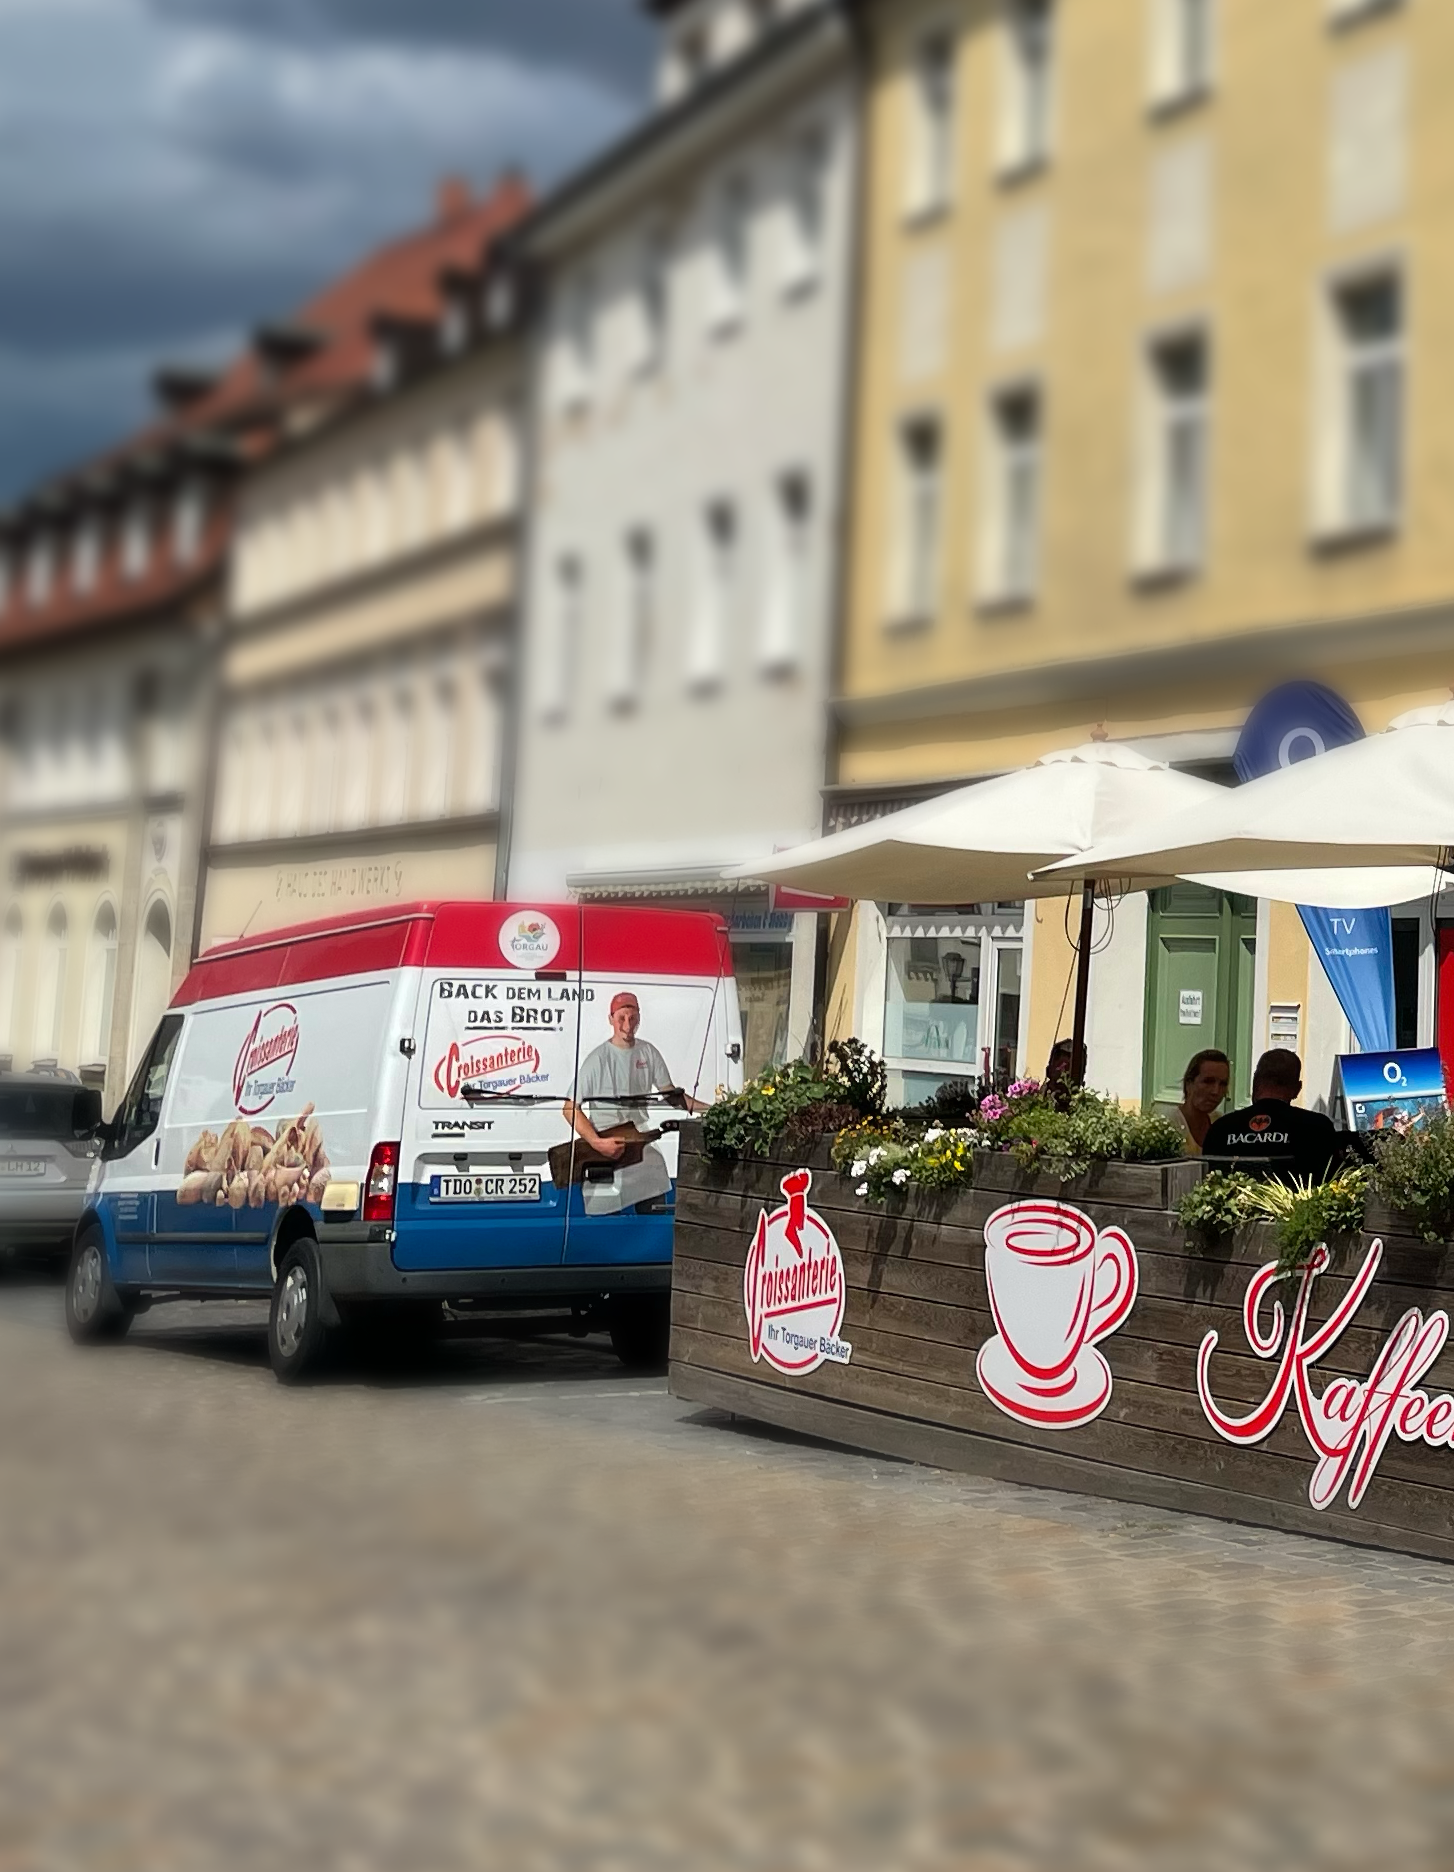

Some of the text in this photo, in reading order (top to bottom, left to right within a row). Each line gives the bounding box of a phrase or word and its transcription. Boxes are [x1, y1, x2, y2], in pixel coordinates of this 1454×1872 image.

[1329, 917, 1356, 936] TV
[1325, 946, 1379, 957] Smartphones
[439, 981, 595, 1003] BACK DEM LAND
[468, 1005, 566, 1024] DAS BROT
[446, 1041, 534, 1099] Croissanterie
[478, 1077, 518, 1092] Torgauer
[519, 1073, 549, 1086] Bäcker
[432, 1120, 494, 1131] TRANSIT
[1227, 1132, 1289, 1145] BACARDI
[443, 1177, 537, 1196] TDO CR 252
[752, 1212, 837, 1358] Croissanterie
[768, 1324, 850, 1360] Ihr Torgauer Bäcker
